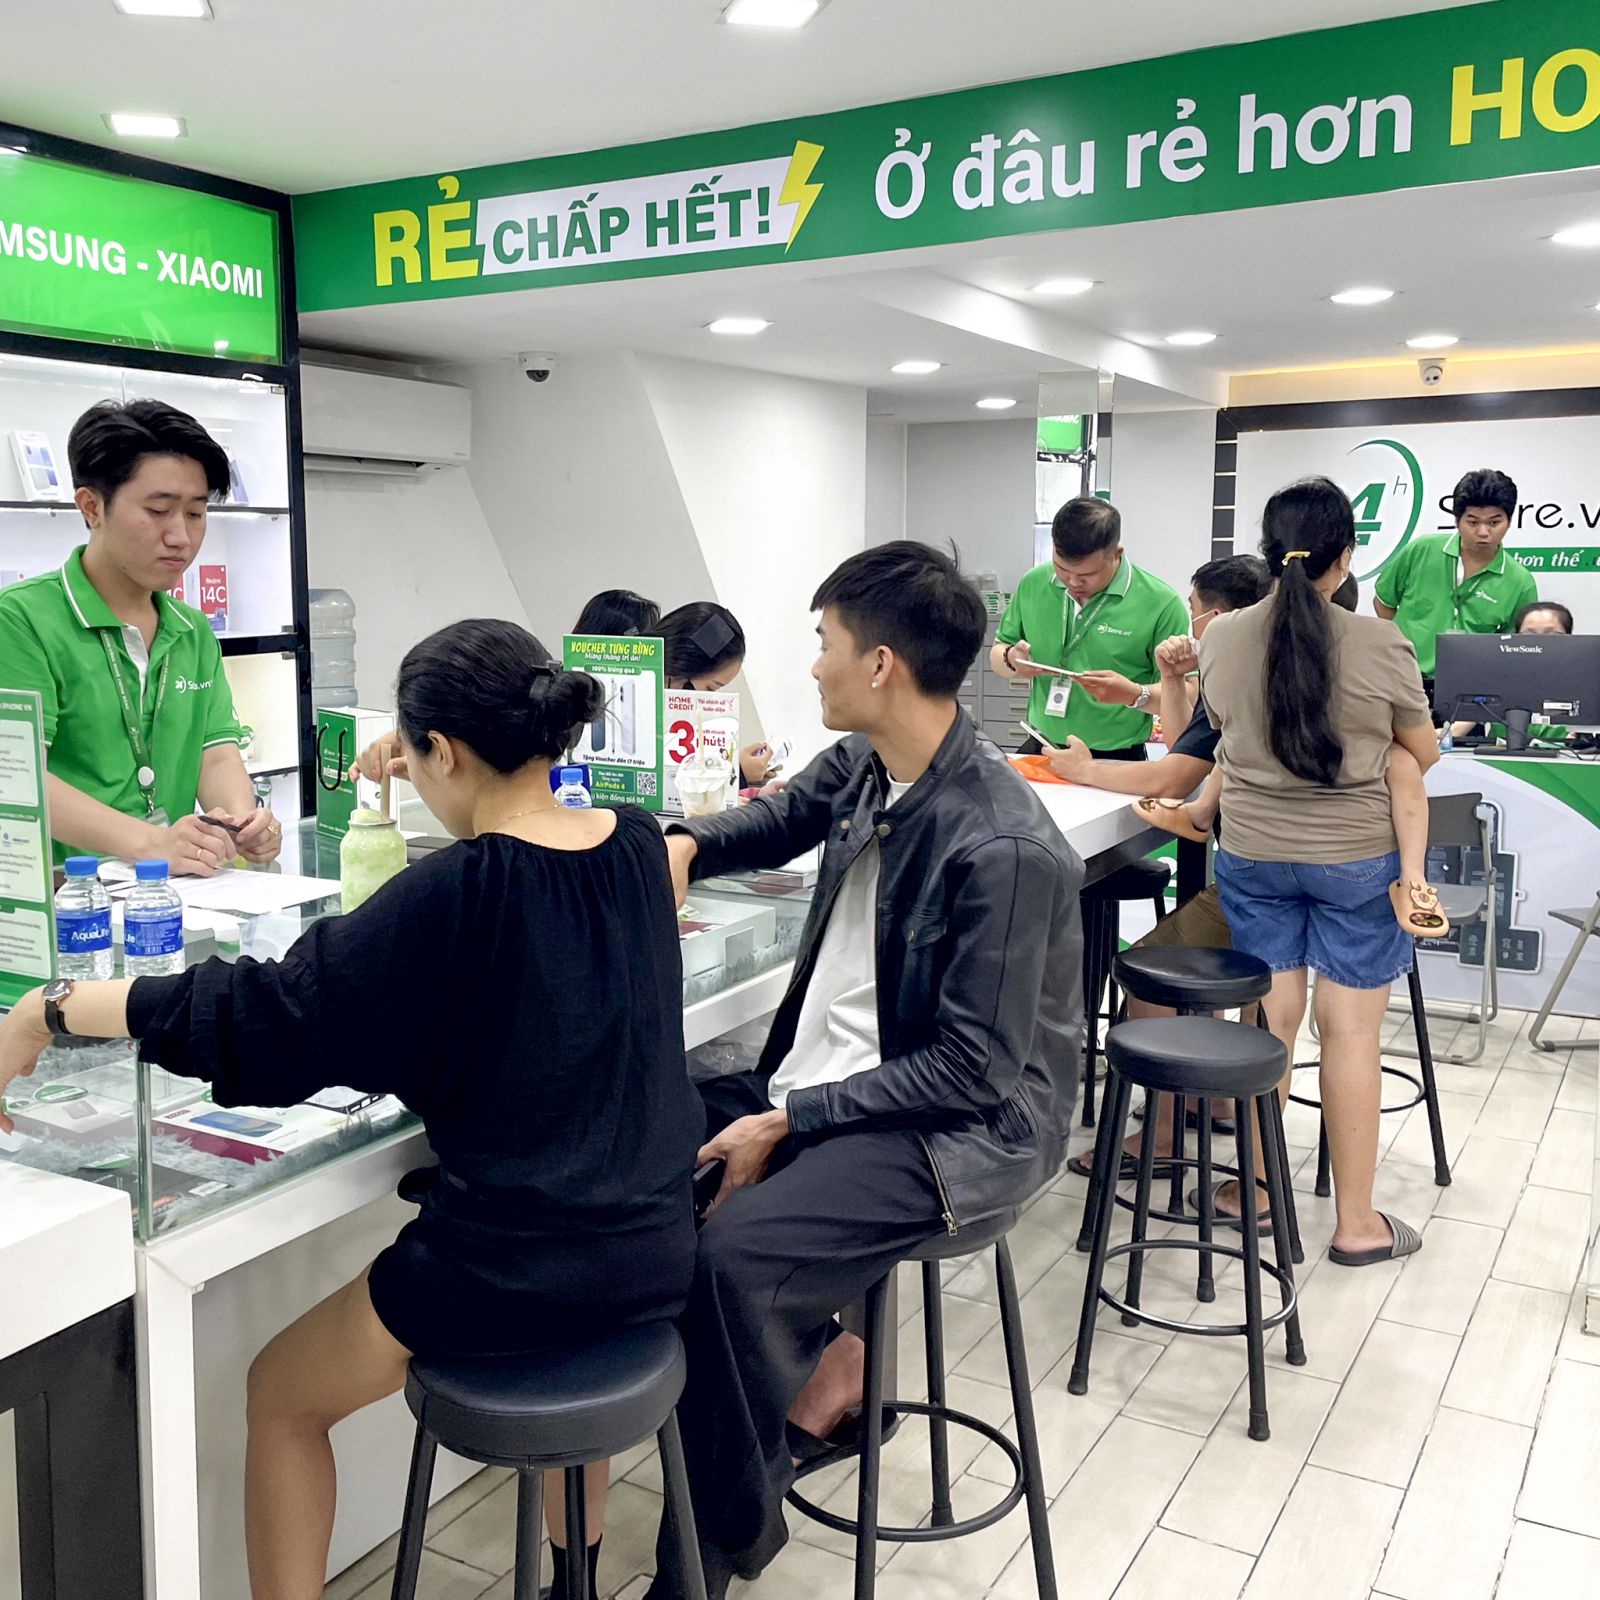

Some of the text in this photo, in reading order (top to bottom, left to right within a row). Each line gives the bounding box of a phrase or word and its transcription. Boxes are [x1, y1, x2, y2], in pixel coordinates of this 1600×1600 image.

[874, 47, 1600, 219] Ở đâu rẻ hơn HO
[373, 174, 771, 287] RẺ CHẤP HẾT!
[0, 220, 127, 276] MSUNG
[156, 249, 263, 299] XIAOMI
[1438, 495, 1600, 530] Sre.v
[1551, 549, 1585, 568] thế
[201, 586, 227, 604] 14C
[571, 642, 607, 653] VOUCHER
[1500, 644, 1543, 654] ViewSonic
[668, 696, 692, 704] HOME
[668, 703, 694, 711] CREDIT
[669, 720, 695, 764] 3
[595, 755, 616, 763] Voucher
[595, 781, 620, 790] AirPods
